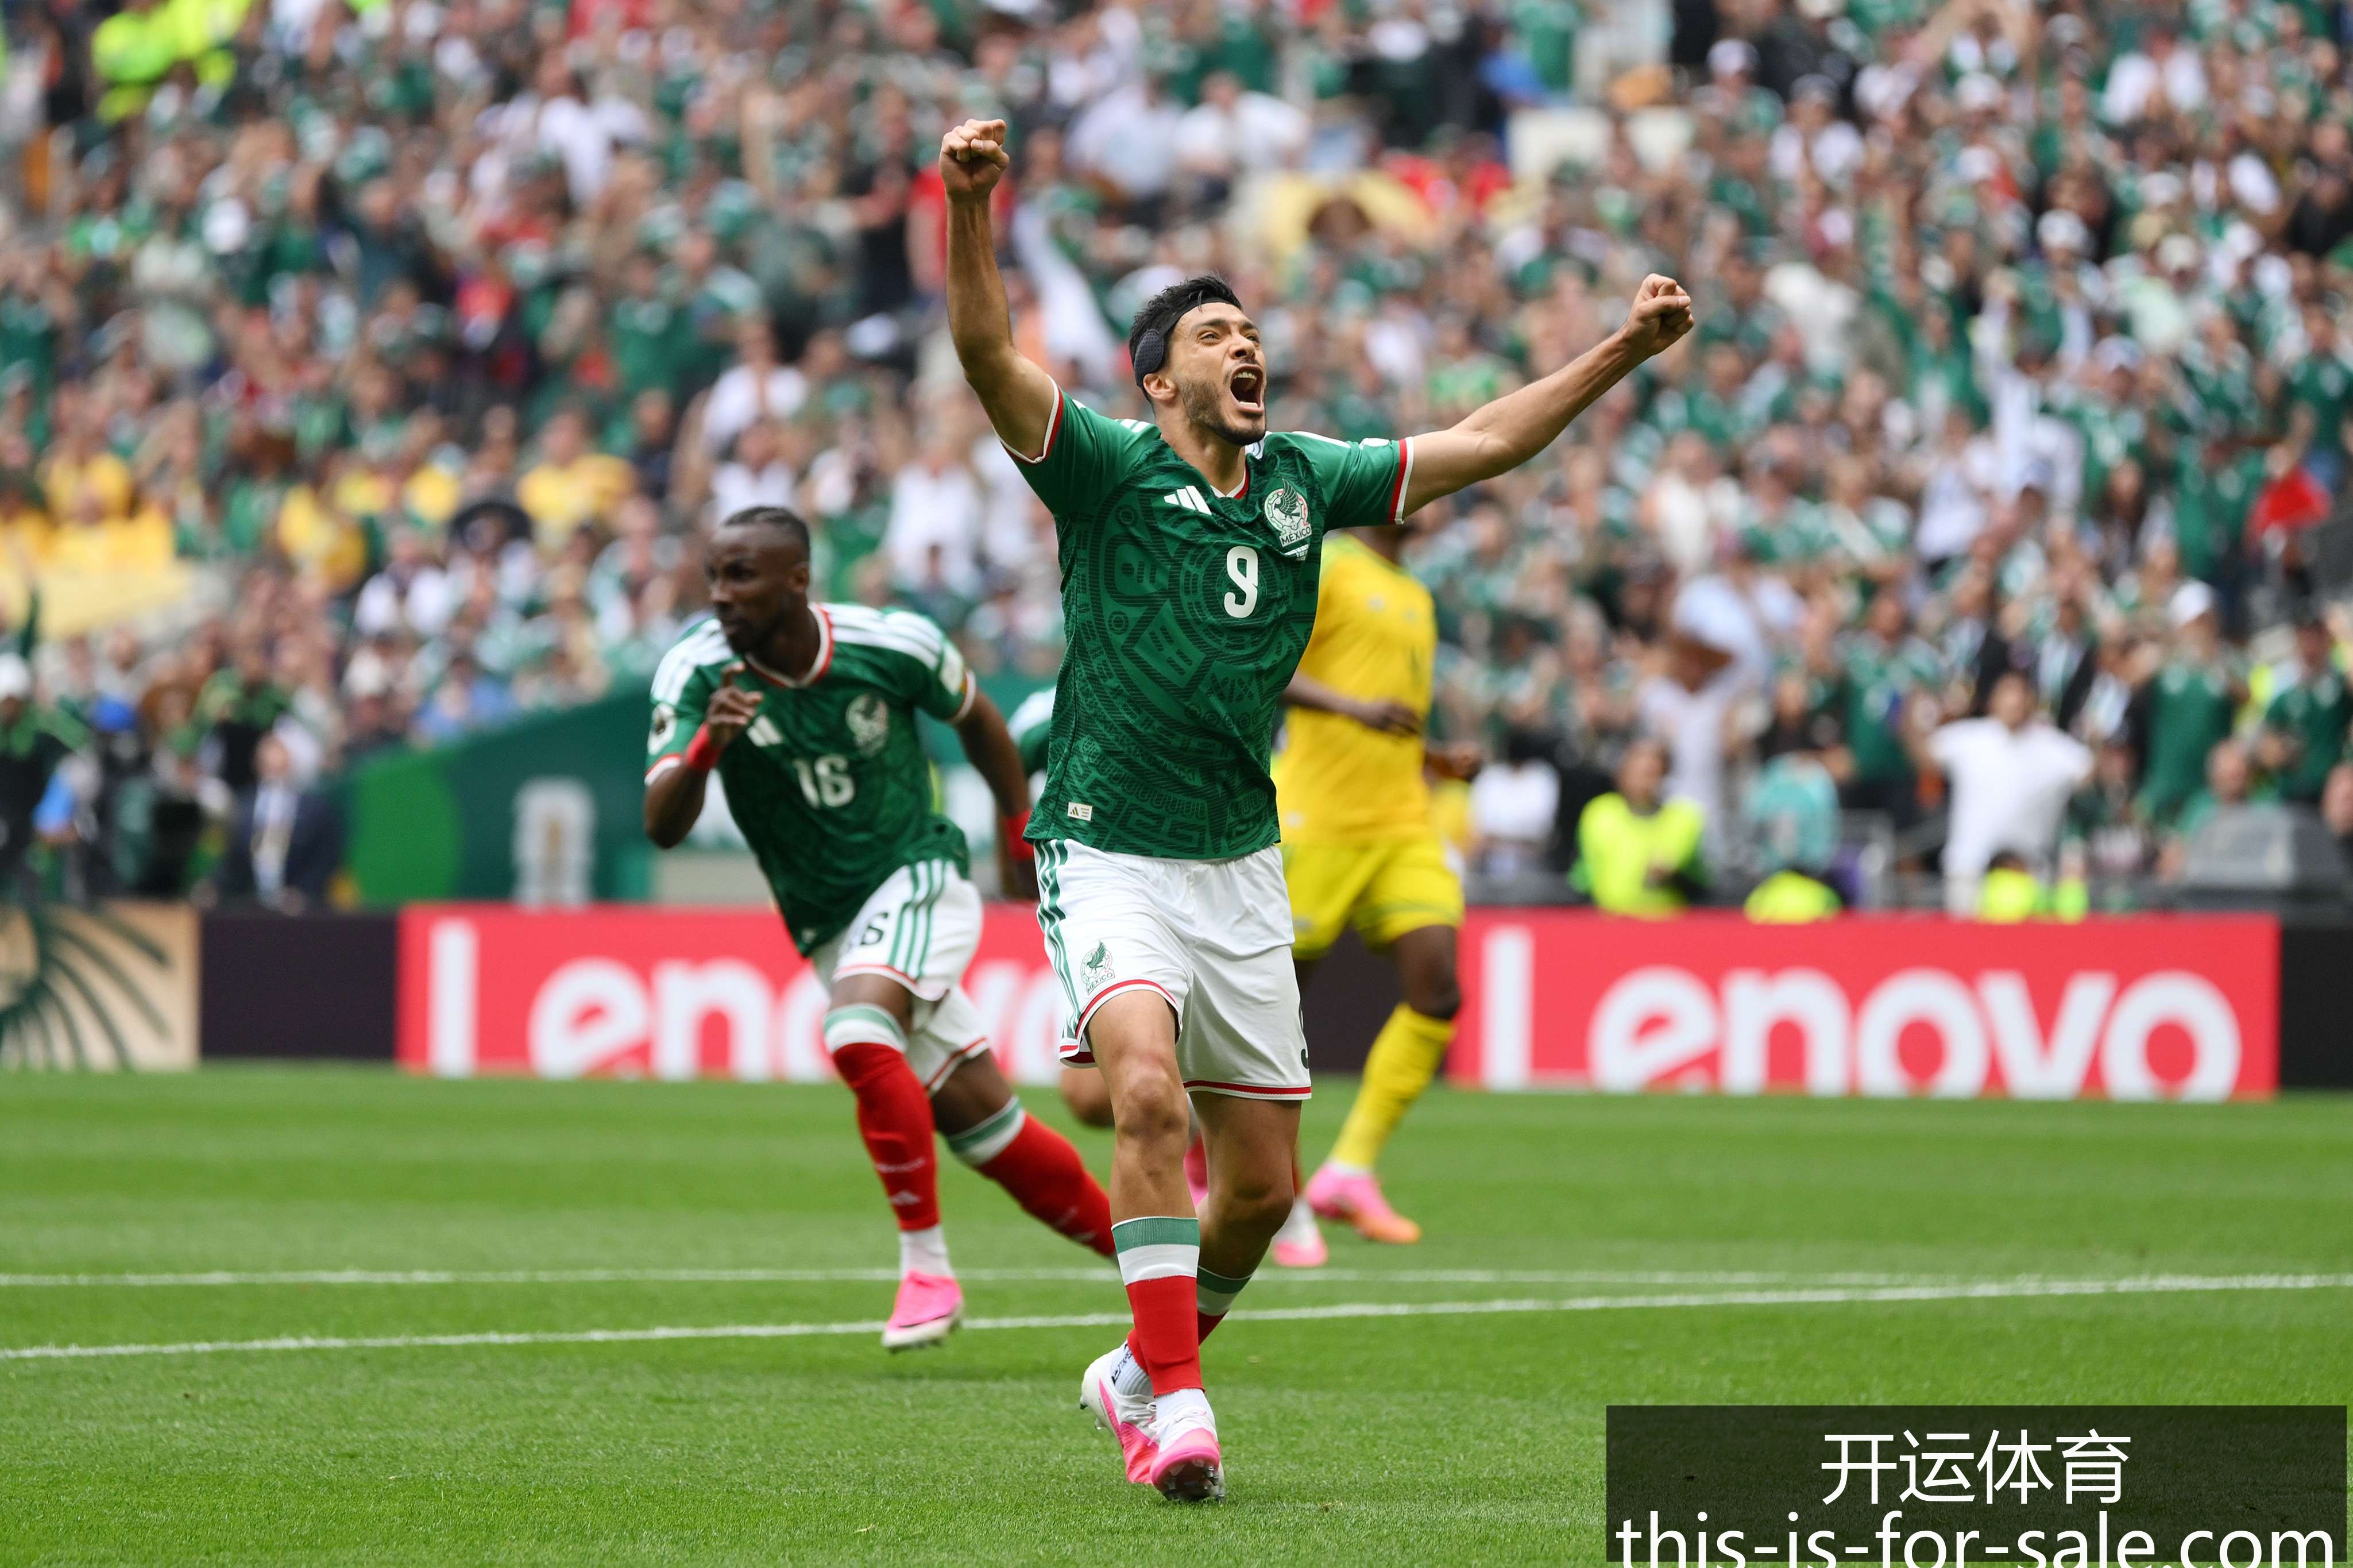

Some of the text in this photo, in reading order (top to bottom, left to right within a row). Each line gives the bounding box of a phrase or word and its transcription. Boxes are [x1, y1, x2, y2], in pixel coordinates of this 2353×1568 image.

[1224, 546, 1258, 618] 9
[792, 754, 855, 808] 16
[1481, 924, 2242, 1102] Lenovo
